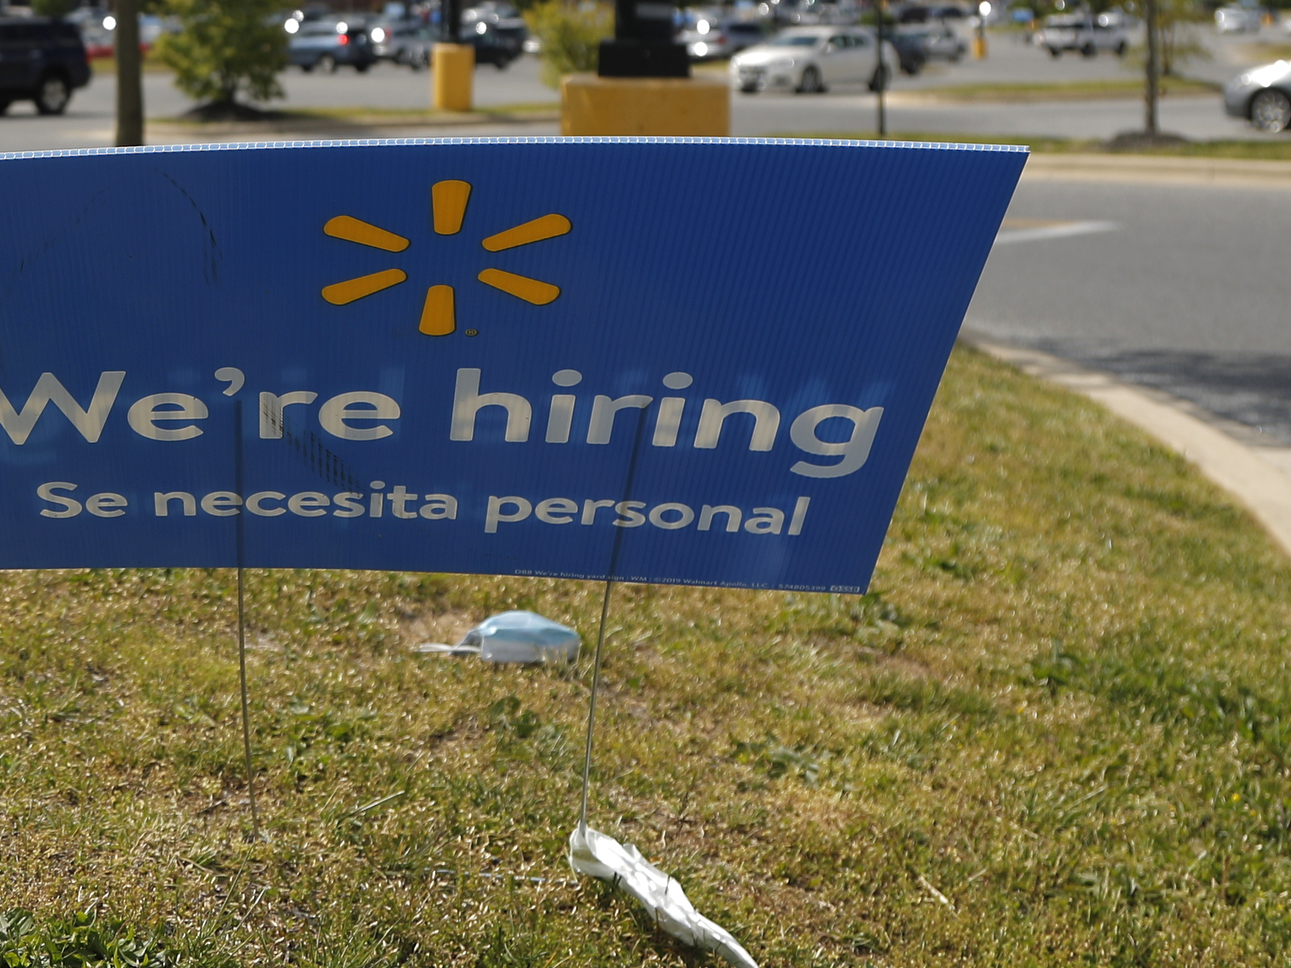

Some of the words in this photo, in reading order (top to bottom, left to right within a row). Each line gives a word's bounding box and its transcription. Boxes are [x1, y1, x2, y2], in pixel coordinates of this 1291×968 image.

[450, 368, 884, 478] hiring
[37, 481, 128, 519] Se
[155, 480, 458, 520] necesita
[485, 495, 811, 535] personal
